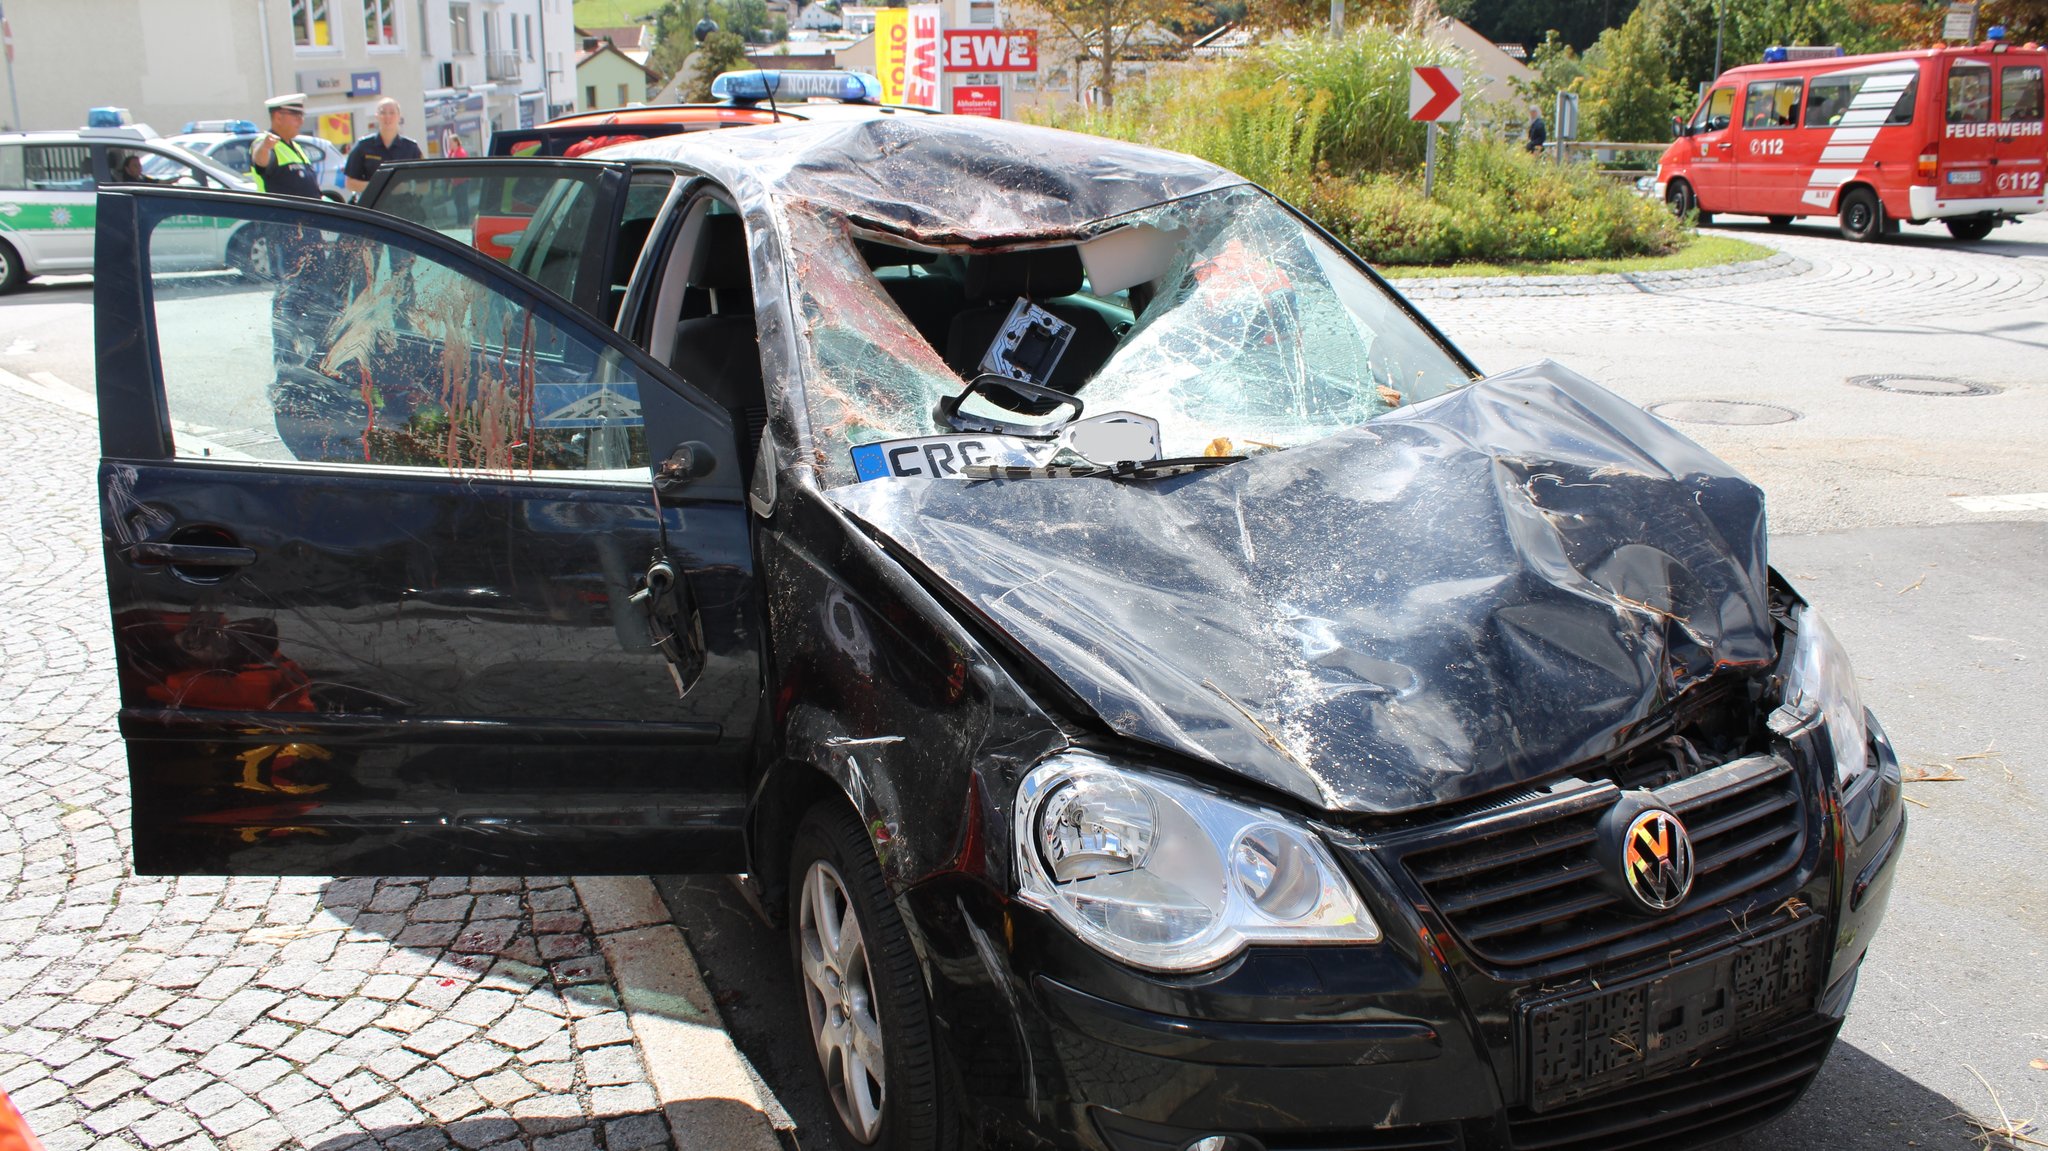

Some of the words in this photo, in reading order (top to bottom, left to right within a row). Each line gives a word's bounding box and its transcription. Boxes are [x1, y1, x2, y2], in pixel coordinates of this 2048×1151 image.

[788, 77, 841, 95] NOTARZT
[1945, 122, 2043, 138] FEUERWEHR
[1760, 138, 1784, 154] 112
[2010, 171, 2041, 190] 112
